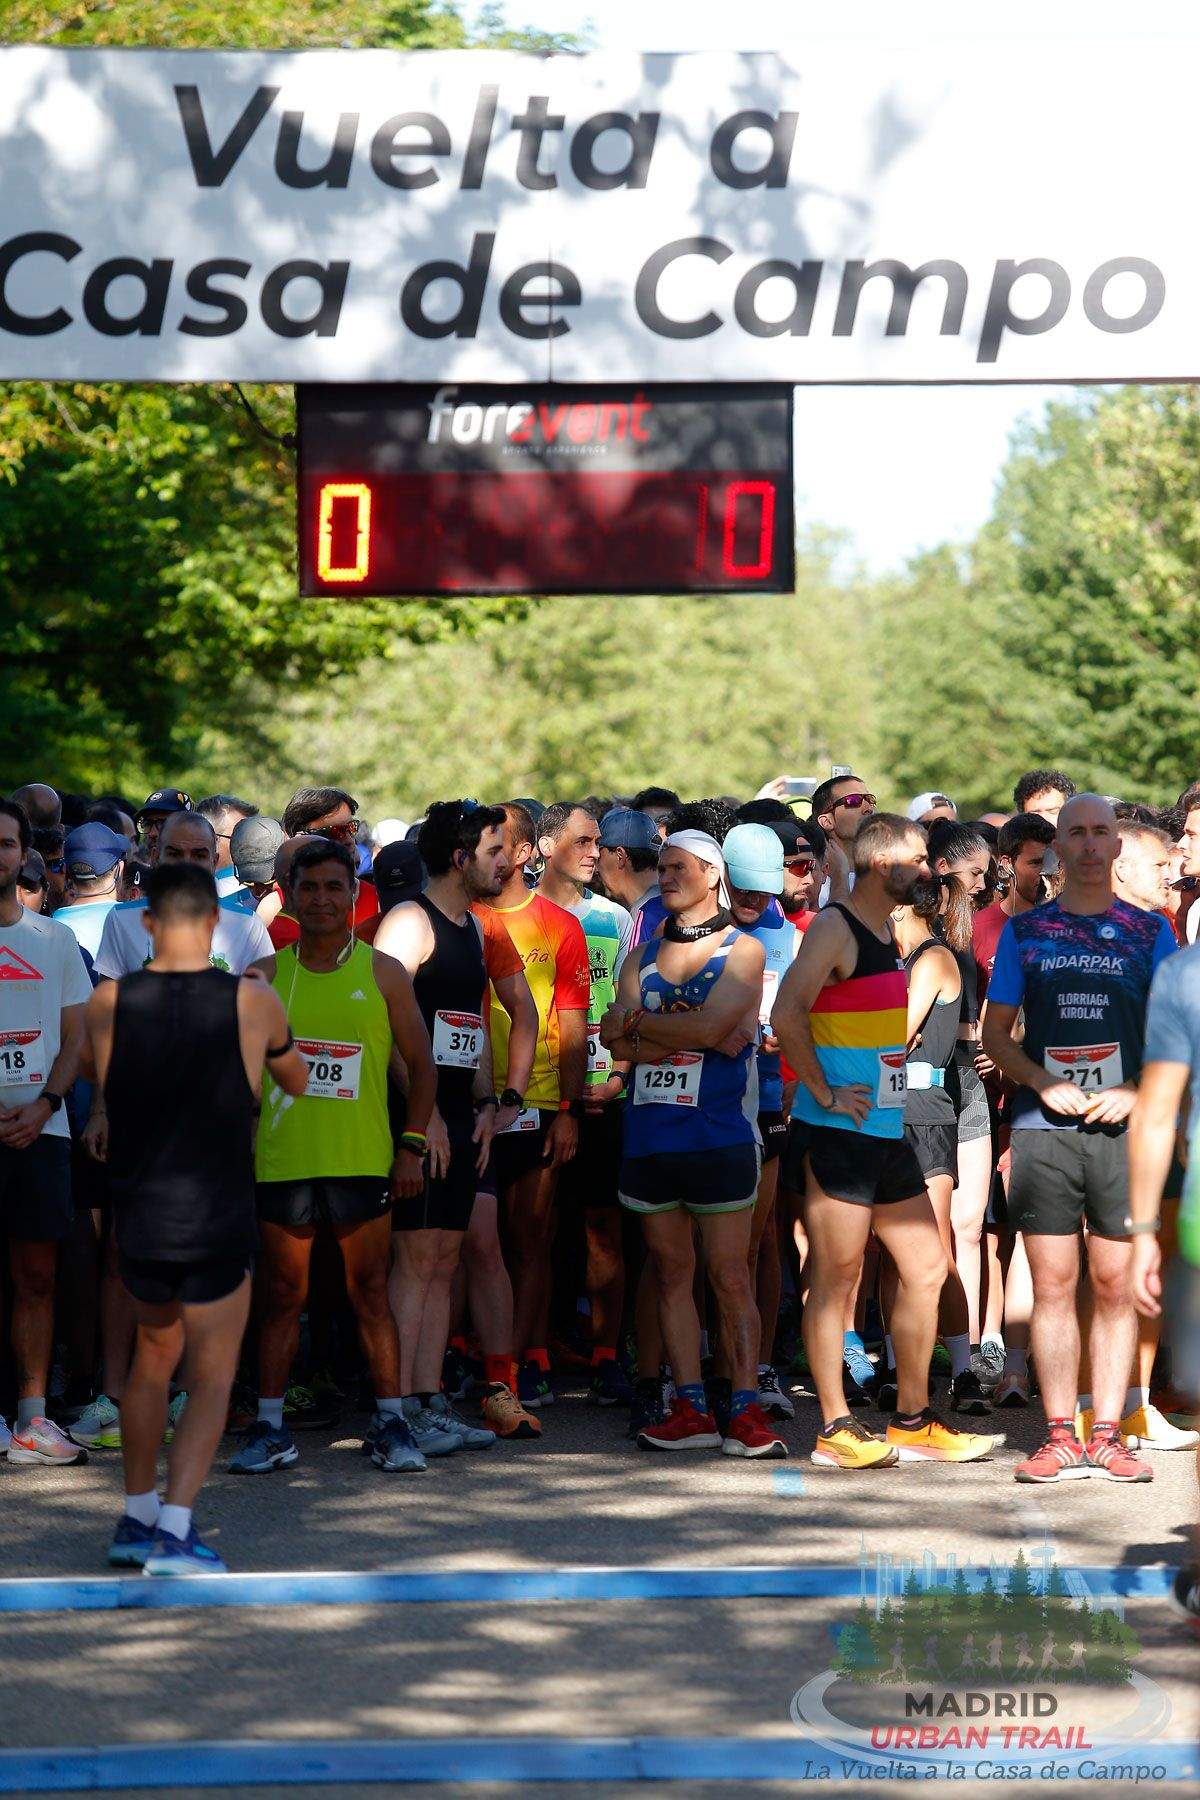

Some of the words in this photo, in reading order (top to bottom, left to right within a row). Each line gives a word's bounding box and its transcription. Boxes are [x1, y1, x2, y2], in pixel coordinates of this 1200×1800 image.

[173, 84, 662, 190] Vuelta
[709, 109, 799, 190] a
[0, 231, 351, 339] Casa
[401, 231, 582, 340] de
[634, 236, 1166, 363] Campo
[427, 387, 653, 445] forevent
[318, 483, 371, 582] 0
[1041, 955, 1124, 971] INDARPAK
[1058, 993, 1110, 1006] ELORRIAGA
[1060, 1006, 1103, 1019] KIROLAK
[450, 1032, 476, 1052] 376
[644, 1070, 688, 1089] 1291
